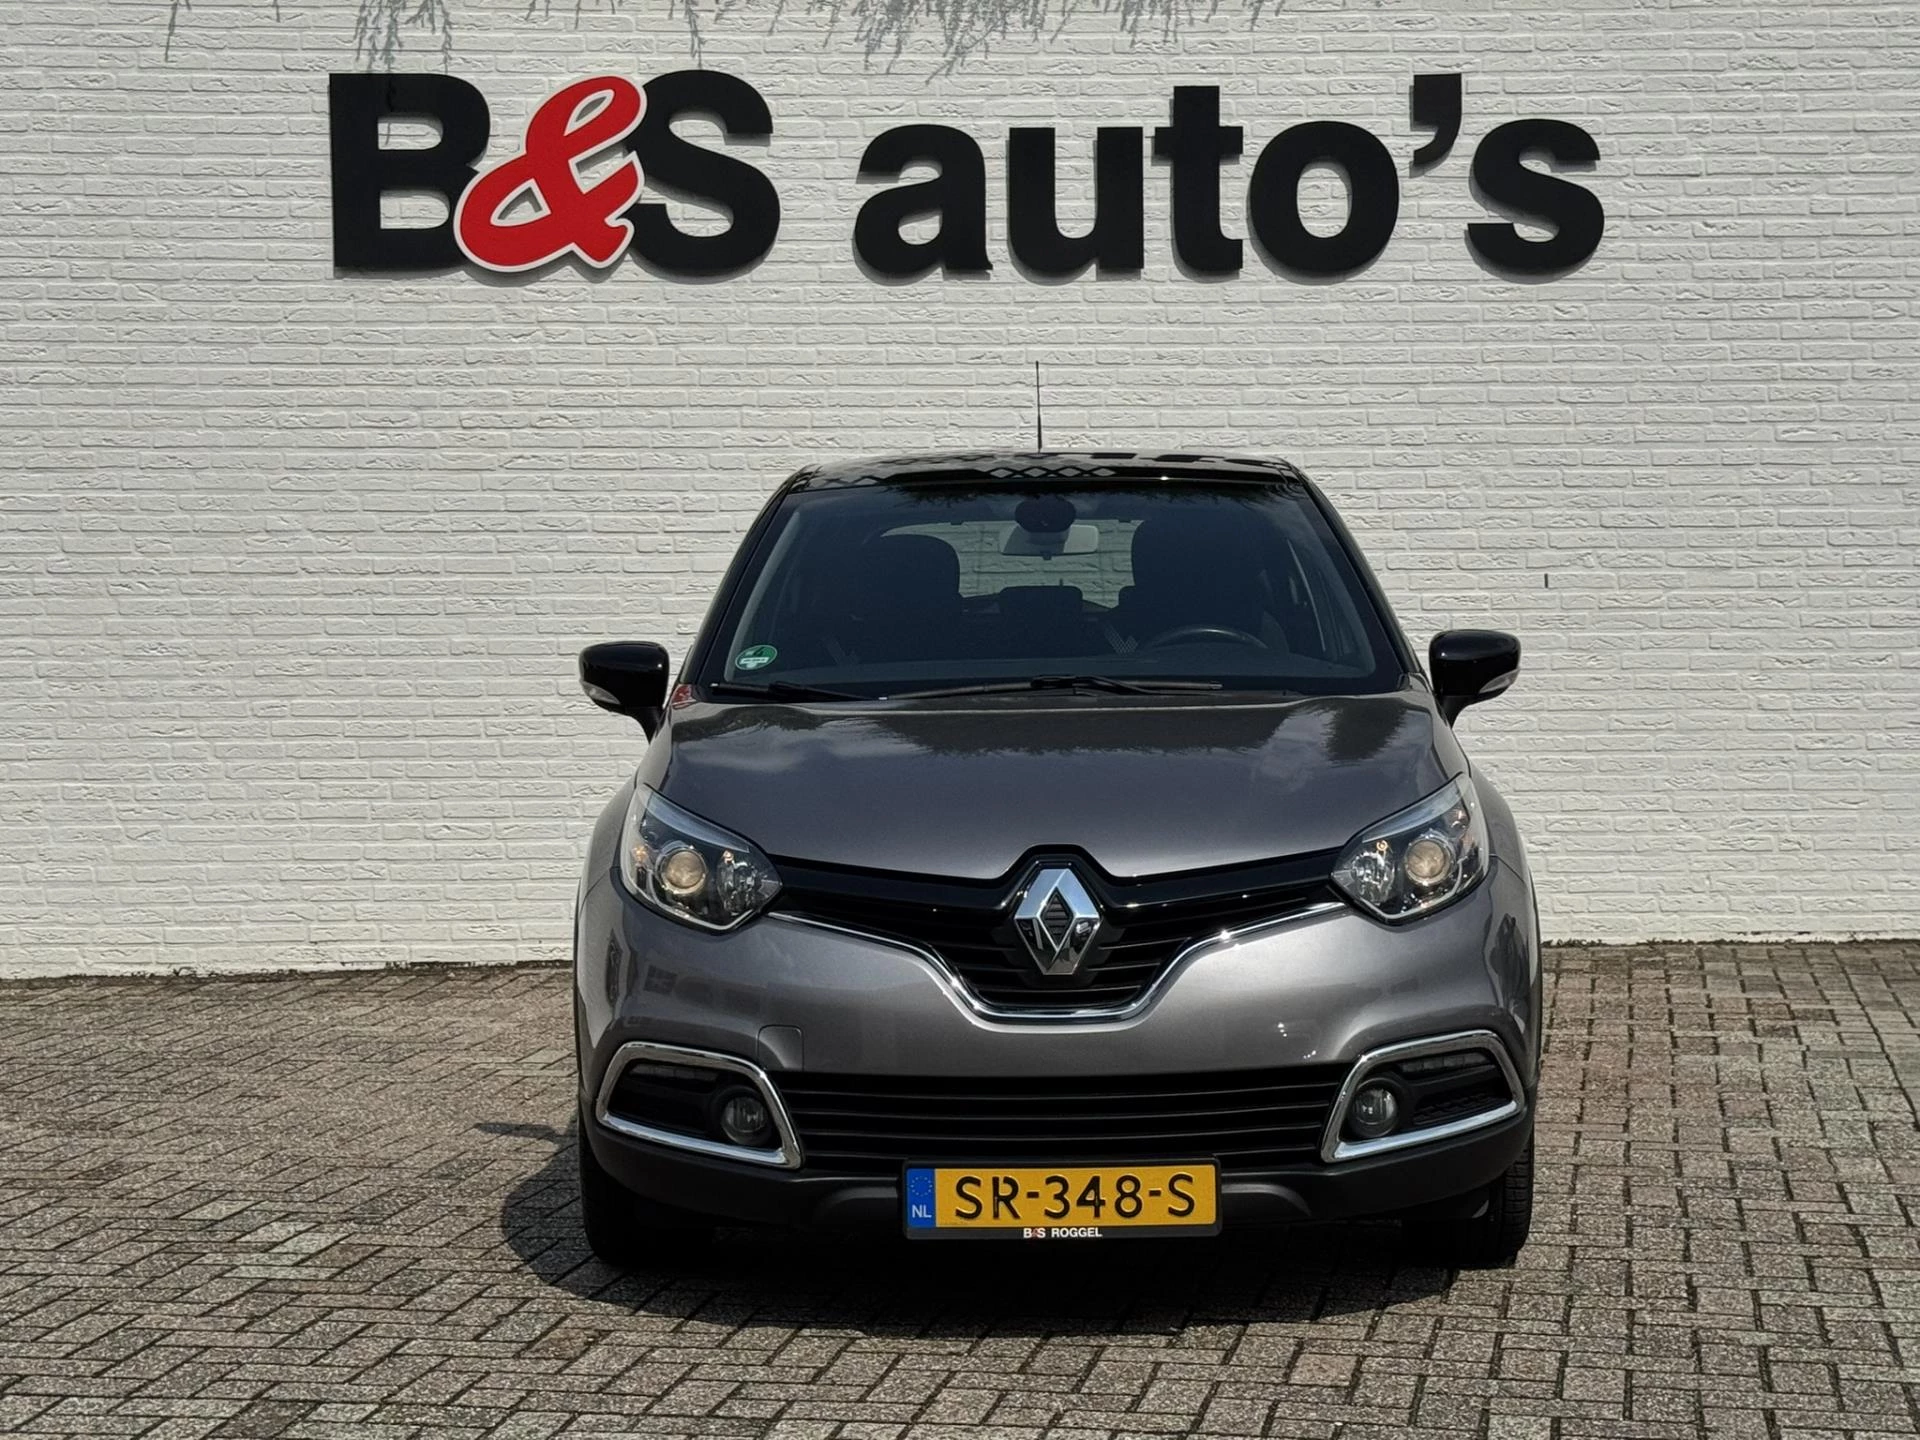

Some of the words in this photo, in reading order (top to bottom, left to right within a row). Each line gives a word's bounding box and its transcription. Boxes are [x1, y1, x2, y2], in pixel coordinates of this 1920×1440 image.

[329, 70, 780, 276] B&S
[853, 74, 1604, 274] auto's
[954, 1173, 1195, 1219] SR-348-S
[911, 1205, 932, 1219] NL
[1051, 1227, 1103, 1238] ROGGEL
